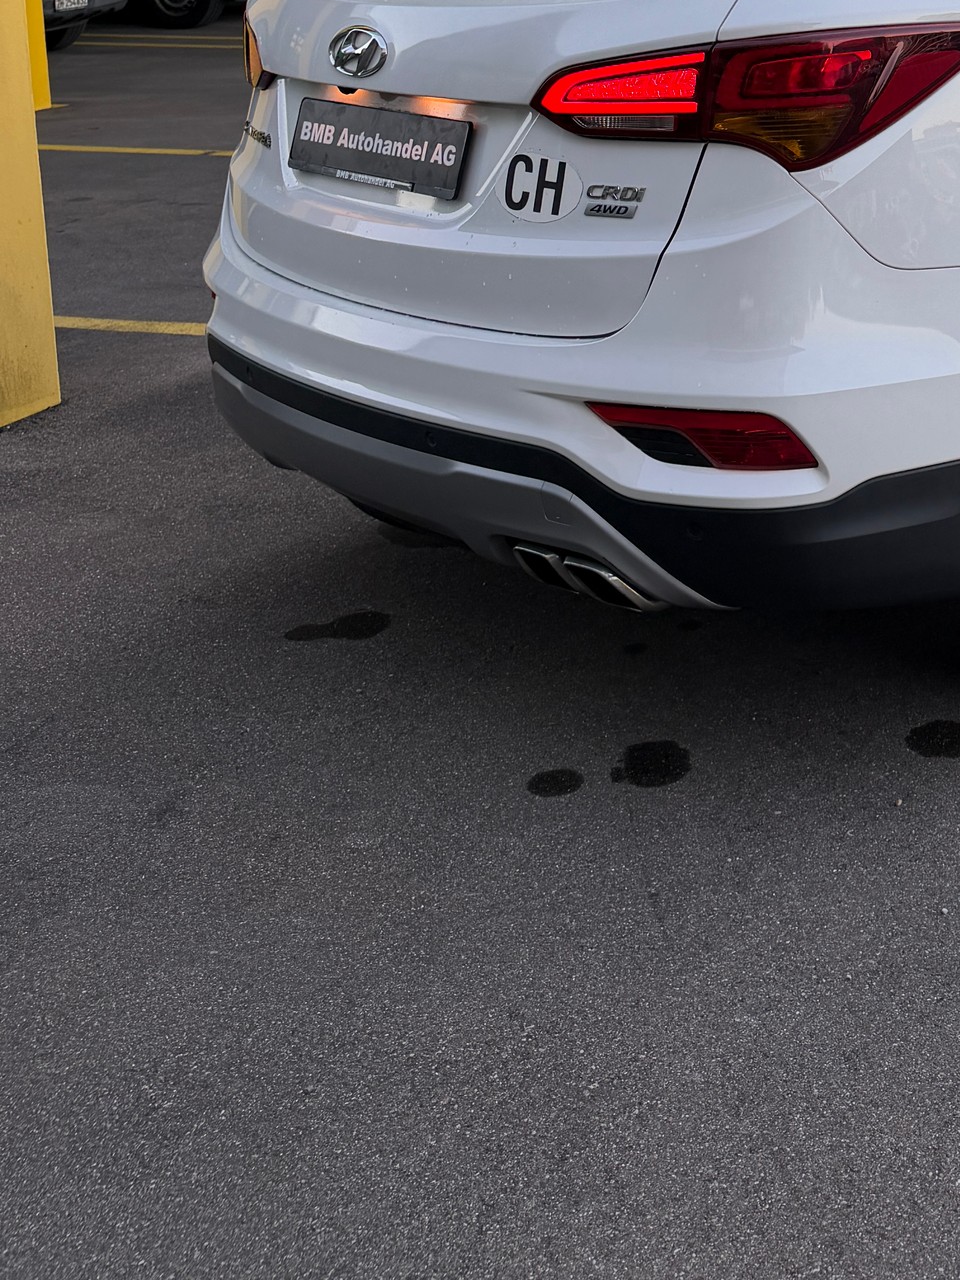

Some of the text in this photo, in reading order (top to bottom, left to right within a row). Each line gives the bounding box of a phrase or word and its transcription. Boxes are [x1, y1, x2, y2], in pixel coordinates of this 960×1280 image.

[300, 121, 336, 145] BMB
[337, 128, 429, 162] Autohandel
[430, 142, 457, 167] AG
[336, 169, 395, 189] BMB Autohandel AG
[505, 154, 567, 216] CH
[590, 204, 629, 216] 4WD
